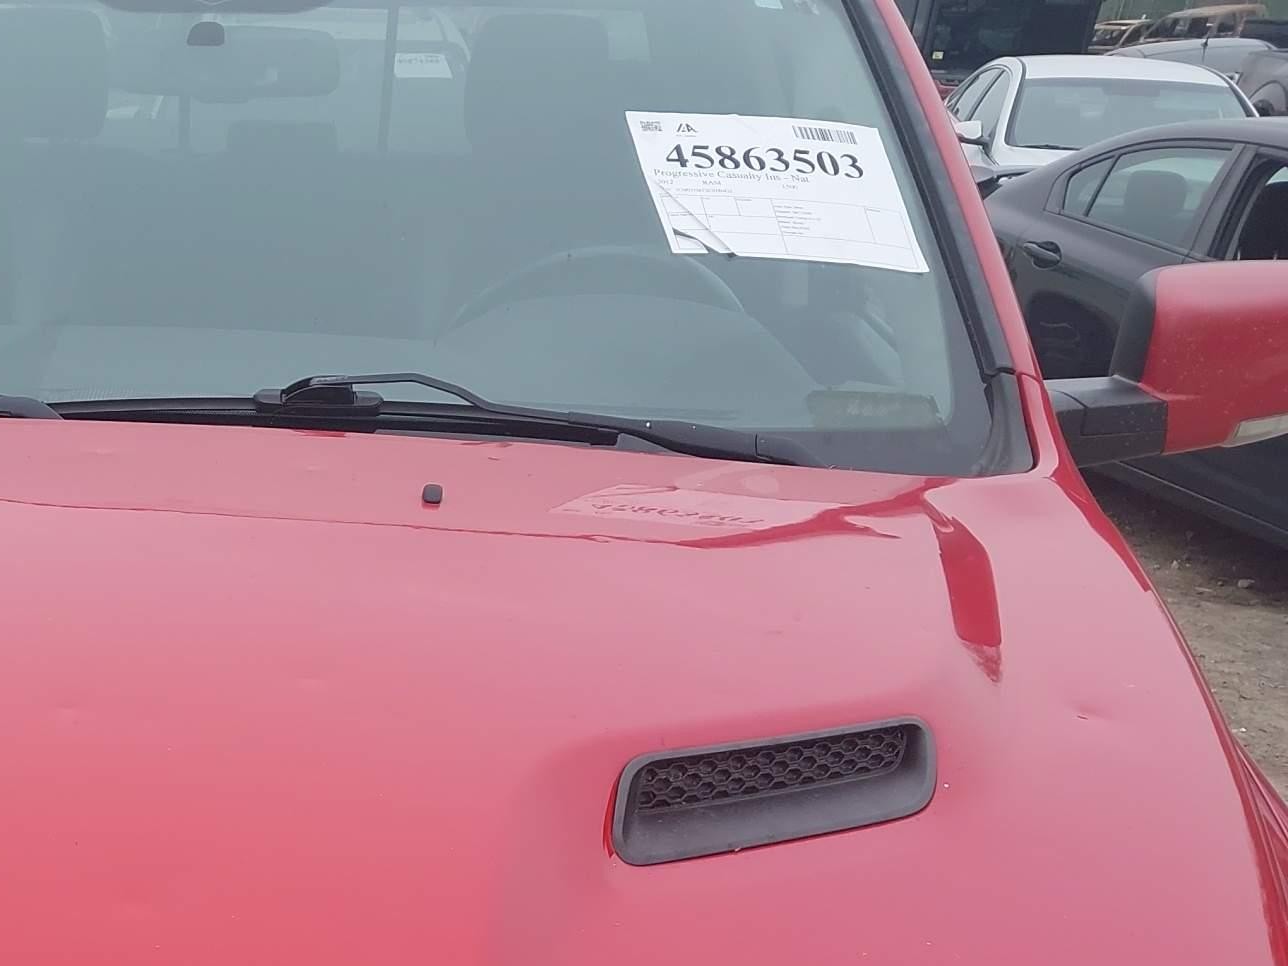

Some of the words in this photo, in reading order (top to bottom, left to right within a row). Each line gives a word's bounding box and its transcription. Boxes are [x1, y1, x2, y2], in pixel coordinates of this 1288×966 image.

[666, 143, 864, 179] 45863503
[654, 168, 715, 179] Progressive
[717, 170, 761, 182] Casualty
[765, 172, 781, 181] Ins
